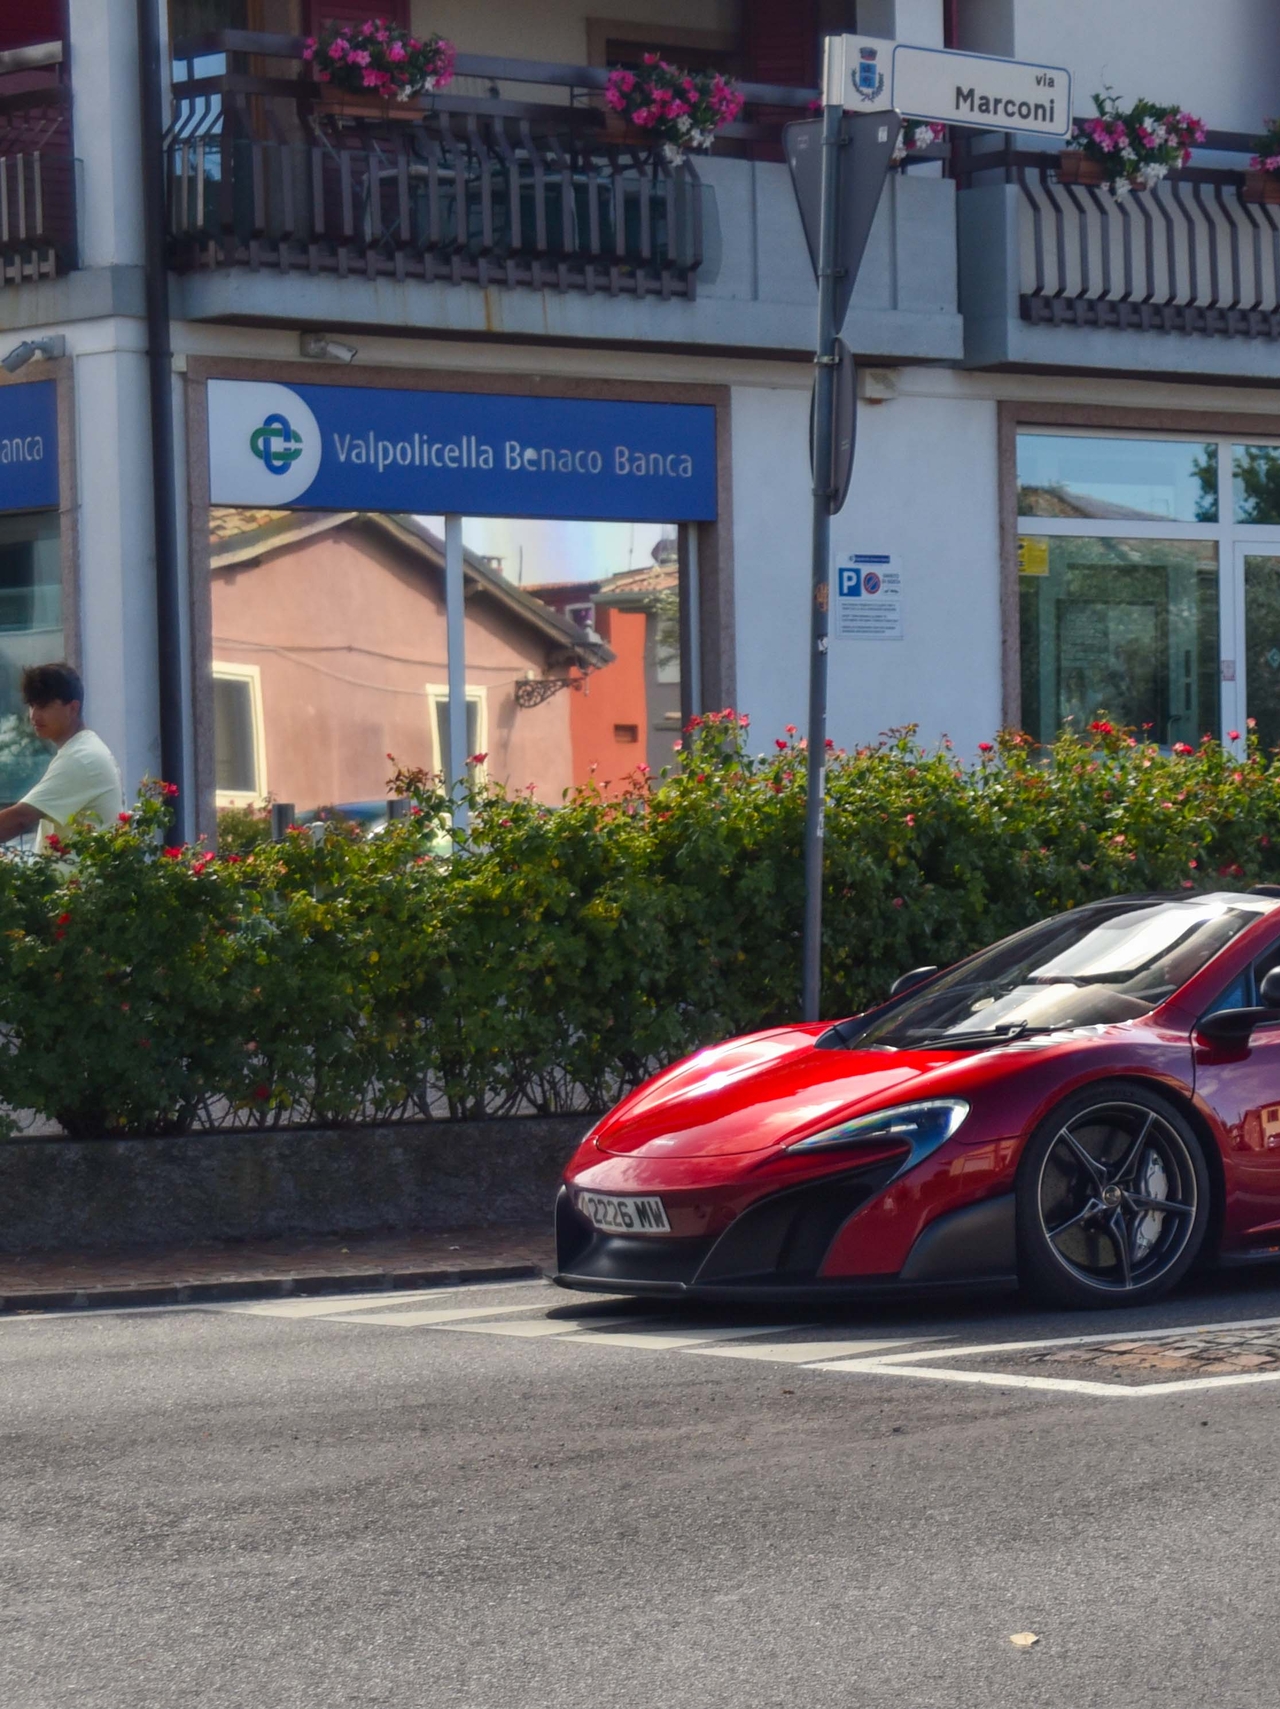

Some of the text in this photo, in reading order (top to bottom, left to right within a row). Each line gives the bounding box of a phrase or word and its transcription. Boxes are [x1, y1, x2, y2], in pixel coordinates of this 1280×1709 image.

[1034, 72, 1055, 88] via
[954, 86, 1055, 123] Marconi
[0, 435, 43, 463] anca
[333, 431, 693, 478] Valpolicella Benaco Banca
[633, 1200, 666, 1228] MW
